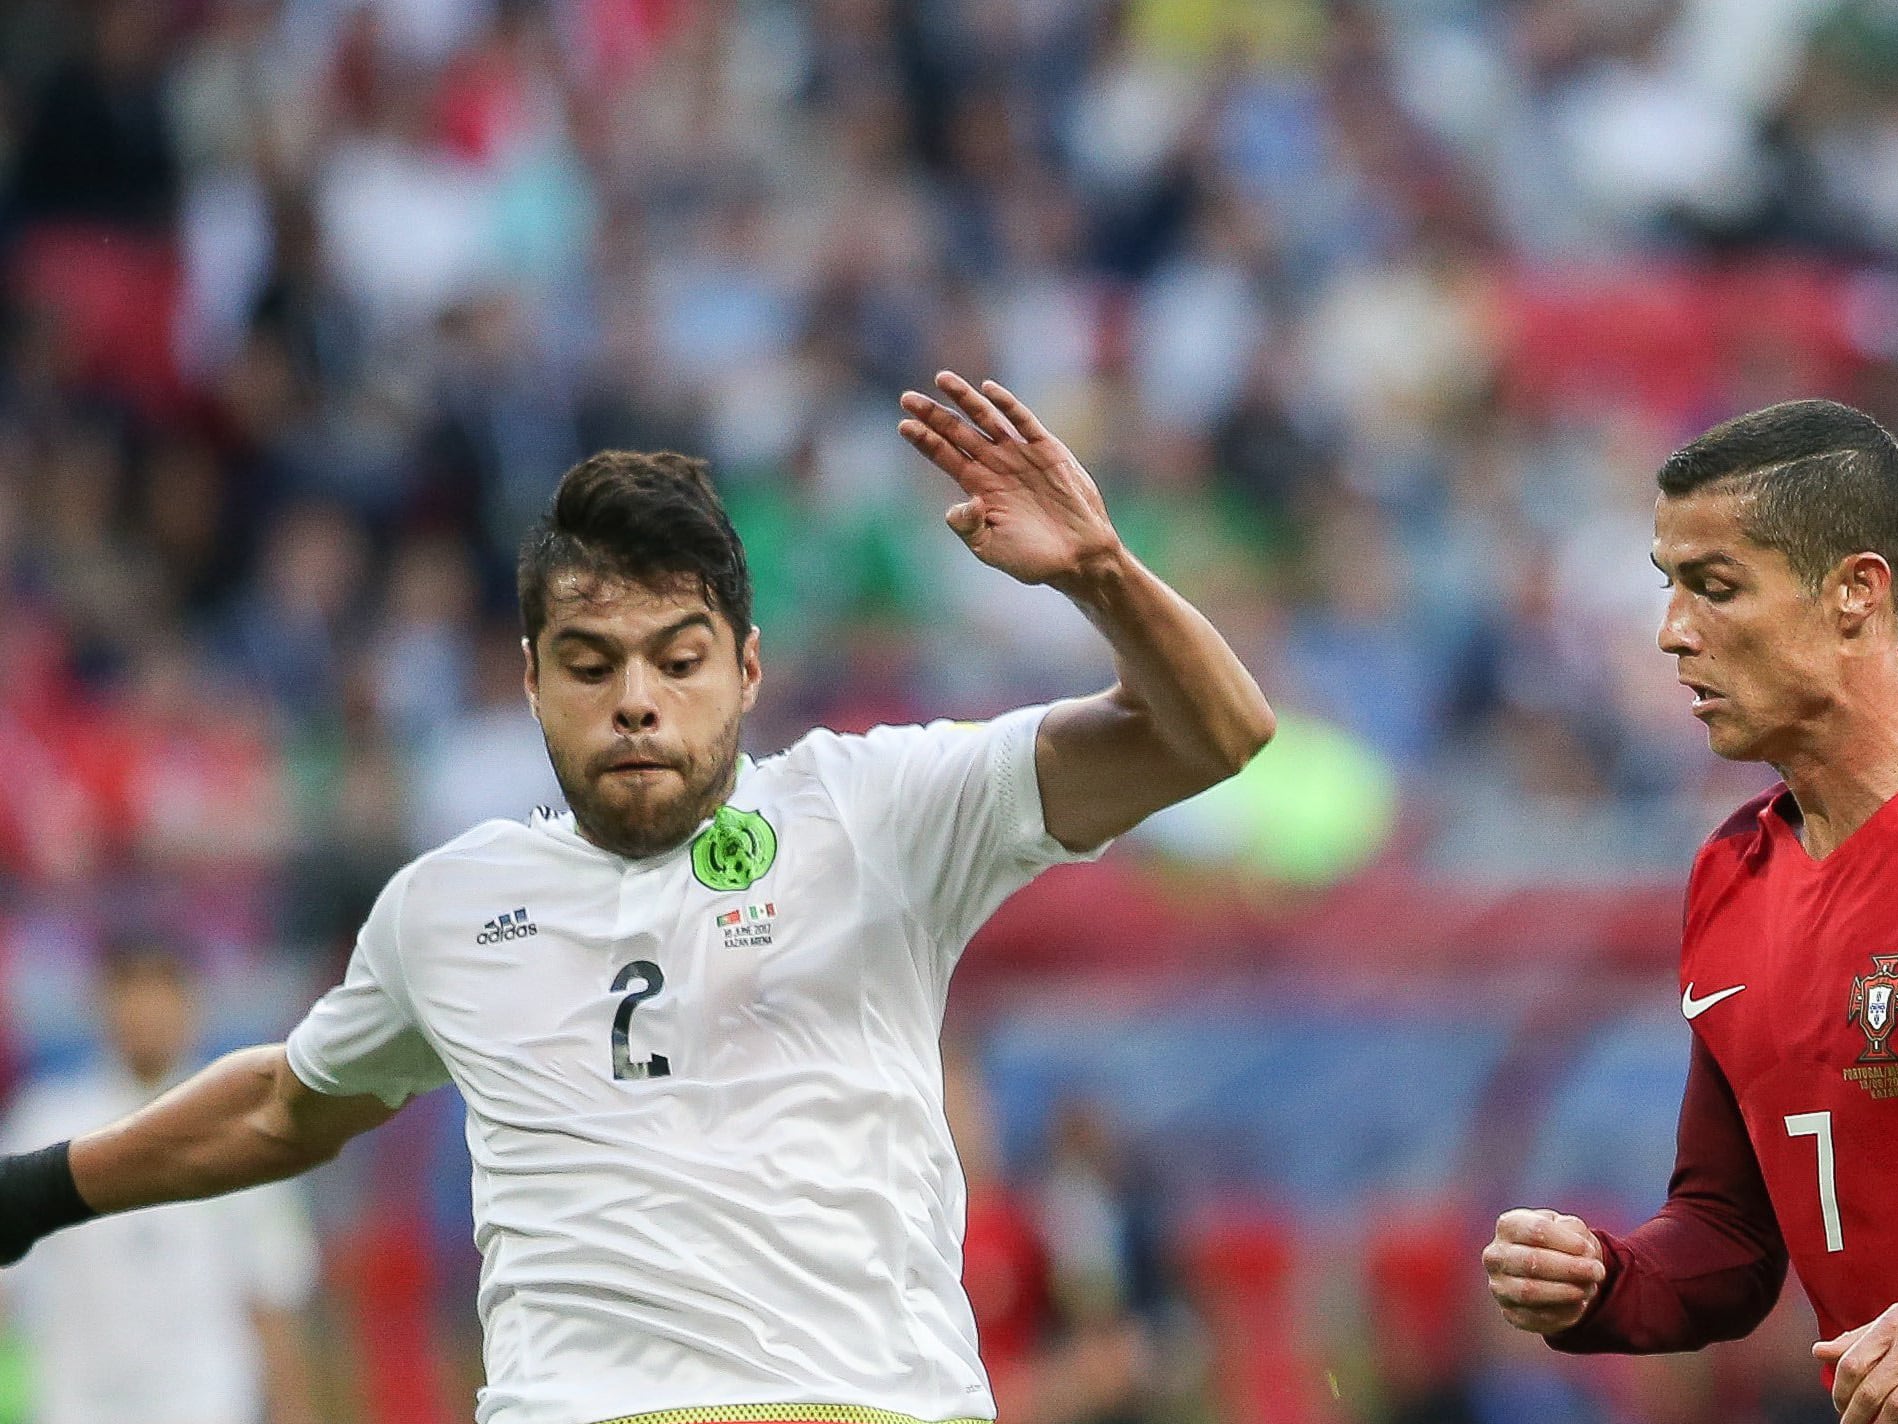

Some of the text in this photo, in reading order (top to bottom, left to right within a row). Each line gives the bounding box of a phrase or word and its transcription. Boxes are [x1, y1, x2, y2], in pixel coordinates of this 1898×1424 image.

[477, 921, 538, 945] adidas
[610, 960, 671, 1080] 2
[1784, 1111, 1843, 1252] 7
